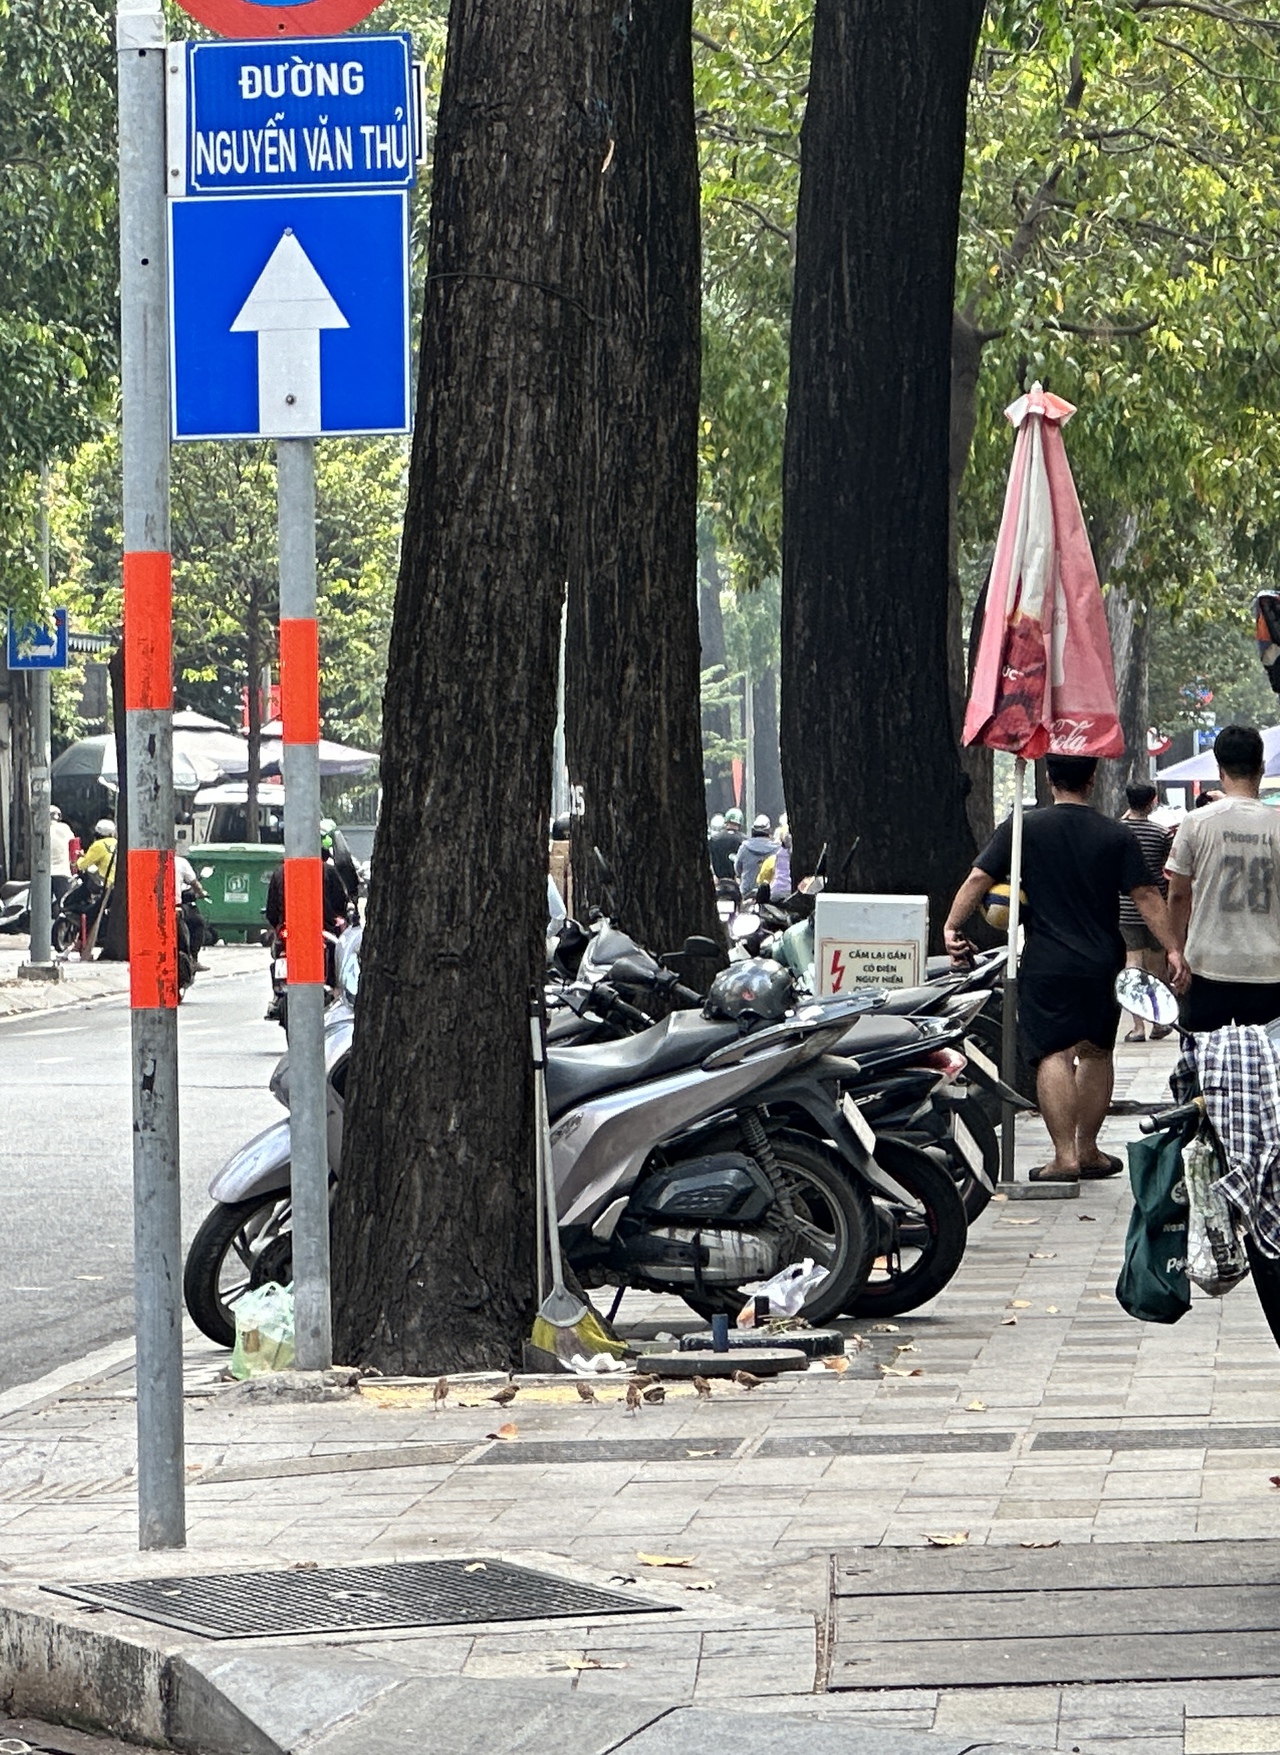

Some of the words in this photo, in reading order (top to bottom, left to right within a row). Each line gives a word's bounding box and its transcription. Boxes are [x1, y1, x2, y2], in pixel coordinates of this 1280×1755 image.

[238, 55, 365, 100] ĐƯỜNG
[196, 111, 297, 175] NGUYỄN
[303, 114, 354, 172] VĂN
[359, 106, 408, 170] THỦ
